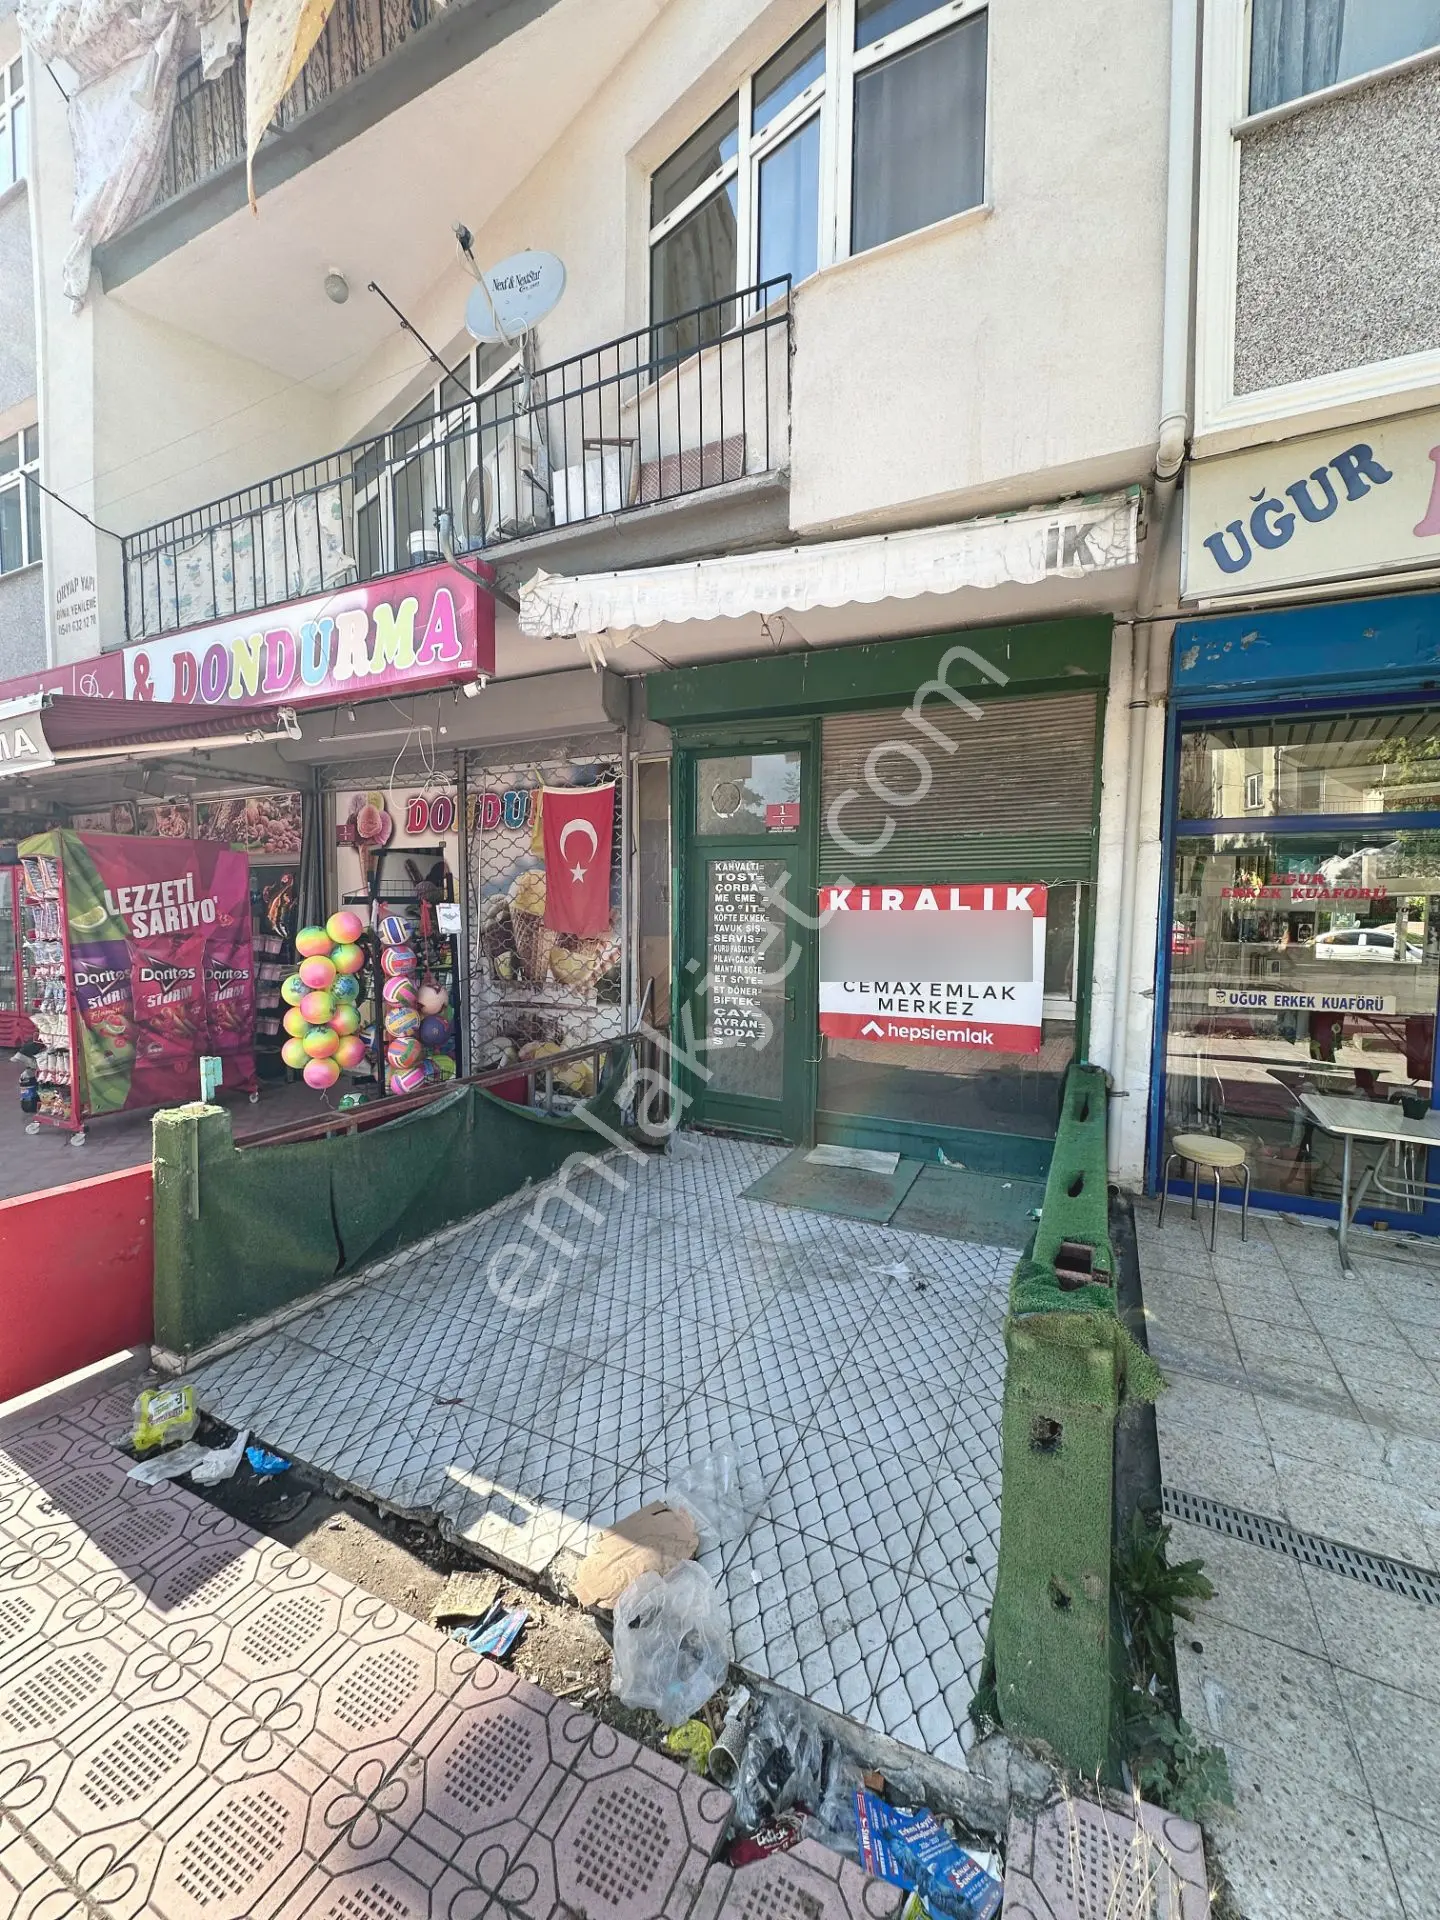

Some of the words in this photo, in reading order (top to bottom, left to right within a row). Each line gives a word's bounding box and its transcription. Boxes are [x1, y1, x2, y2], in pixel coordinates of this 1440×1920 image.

[1203, 443, 1393, 574] UĞUR
[172, 588, 463, 705] DONDURMA
[780, 805, 785, 815] 1
[103, 872, 195, 916] LEZZETİ
[714, 924, 742, 932] TAVUK
[713, 944, 729, 952] KURU
[730, 945, 756, 954] FASULYE
[141, 967, 196, 981] Doritos
[205, 969, 249, 980] Doritos
[714, 964, 741, 973] MANTAR
[74, 970, 131, 986] Doritos
[714, 975, 727, 983] ET
[713, 986, 725, 994] ET
[843, 982, 922, 996] CEMAX
[930, 983, 1016, 1001] EMLAK
[878, 998, 974, 1016] MERKEZ
[1229, 991, 1267, 1006] UĞUR
[1274, 994, 1315, 1008] ERKEK
[1322, 994, 1384, 1011] KUAFÖRÜ
[888, 1023, 994, 1045] hepsiemlak
